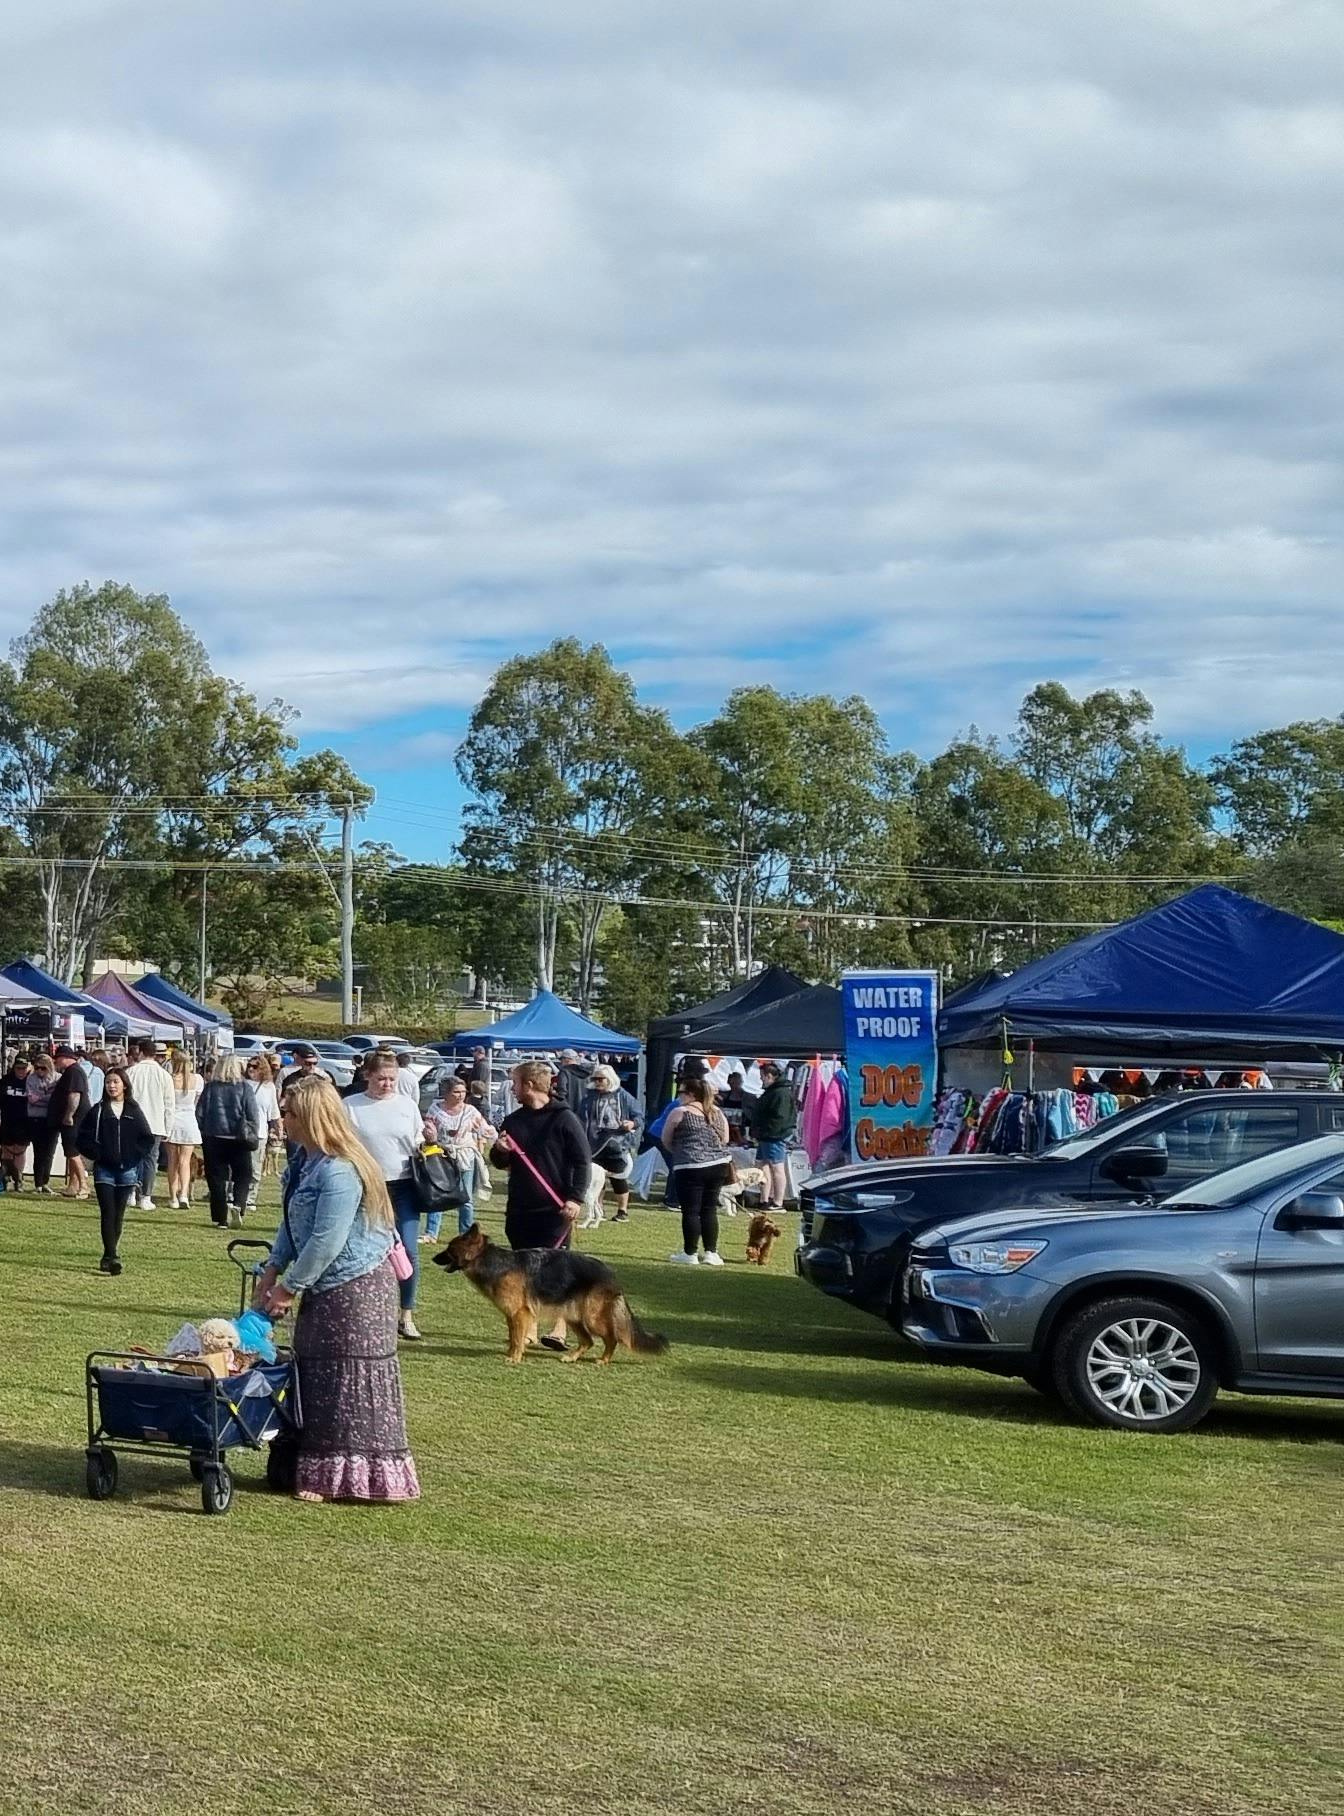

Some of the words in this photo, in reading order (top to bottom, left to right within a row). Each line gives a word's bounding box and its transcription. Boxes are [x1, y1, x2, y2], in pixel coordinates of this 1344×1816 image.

[853, 987, 923, 1009] WATER
[856, 1017, 921, 1038] PROOF
[860, 1064, 924, 1107] DOG
[856, 1117, 931, 1160] Coats
